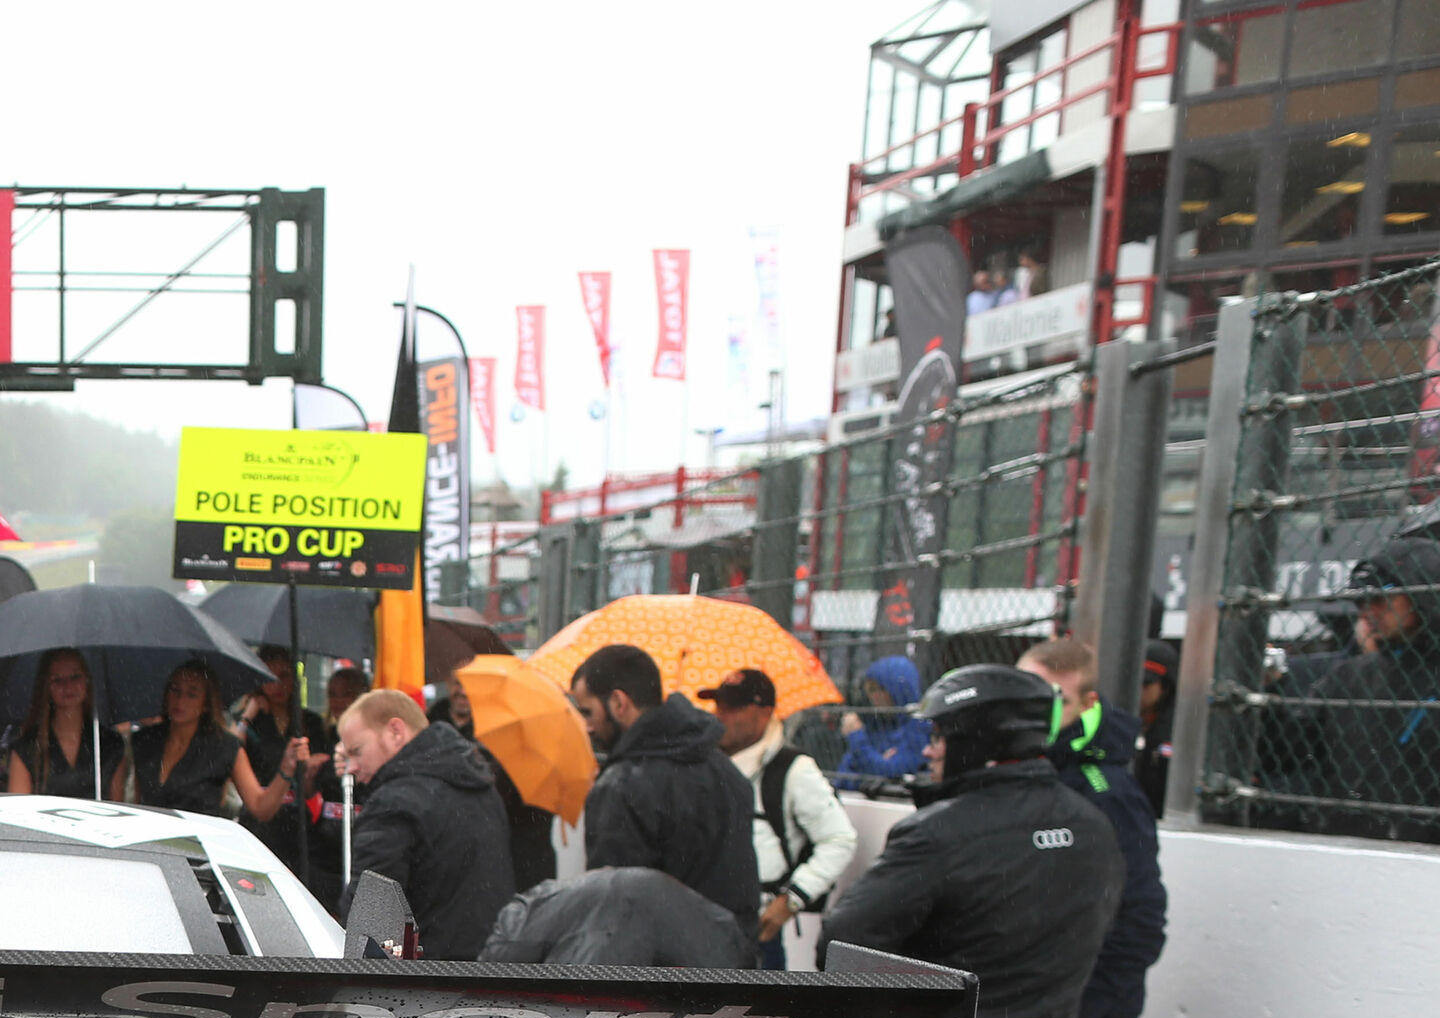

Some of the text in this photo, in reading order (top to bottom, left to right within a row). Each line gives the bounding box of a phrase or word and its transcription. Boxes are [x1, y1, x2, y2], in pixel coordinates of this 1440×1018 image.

[195, 490, 402, 520] POLE POSITION
[222, 525, 365, 558] PRO CUP
